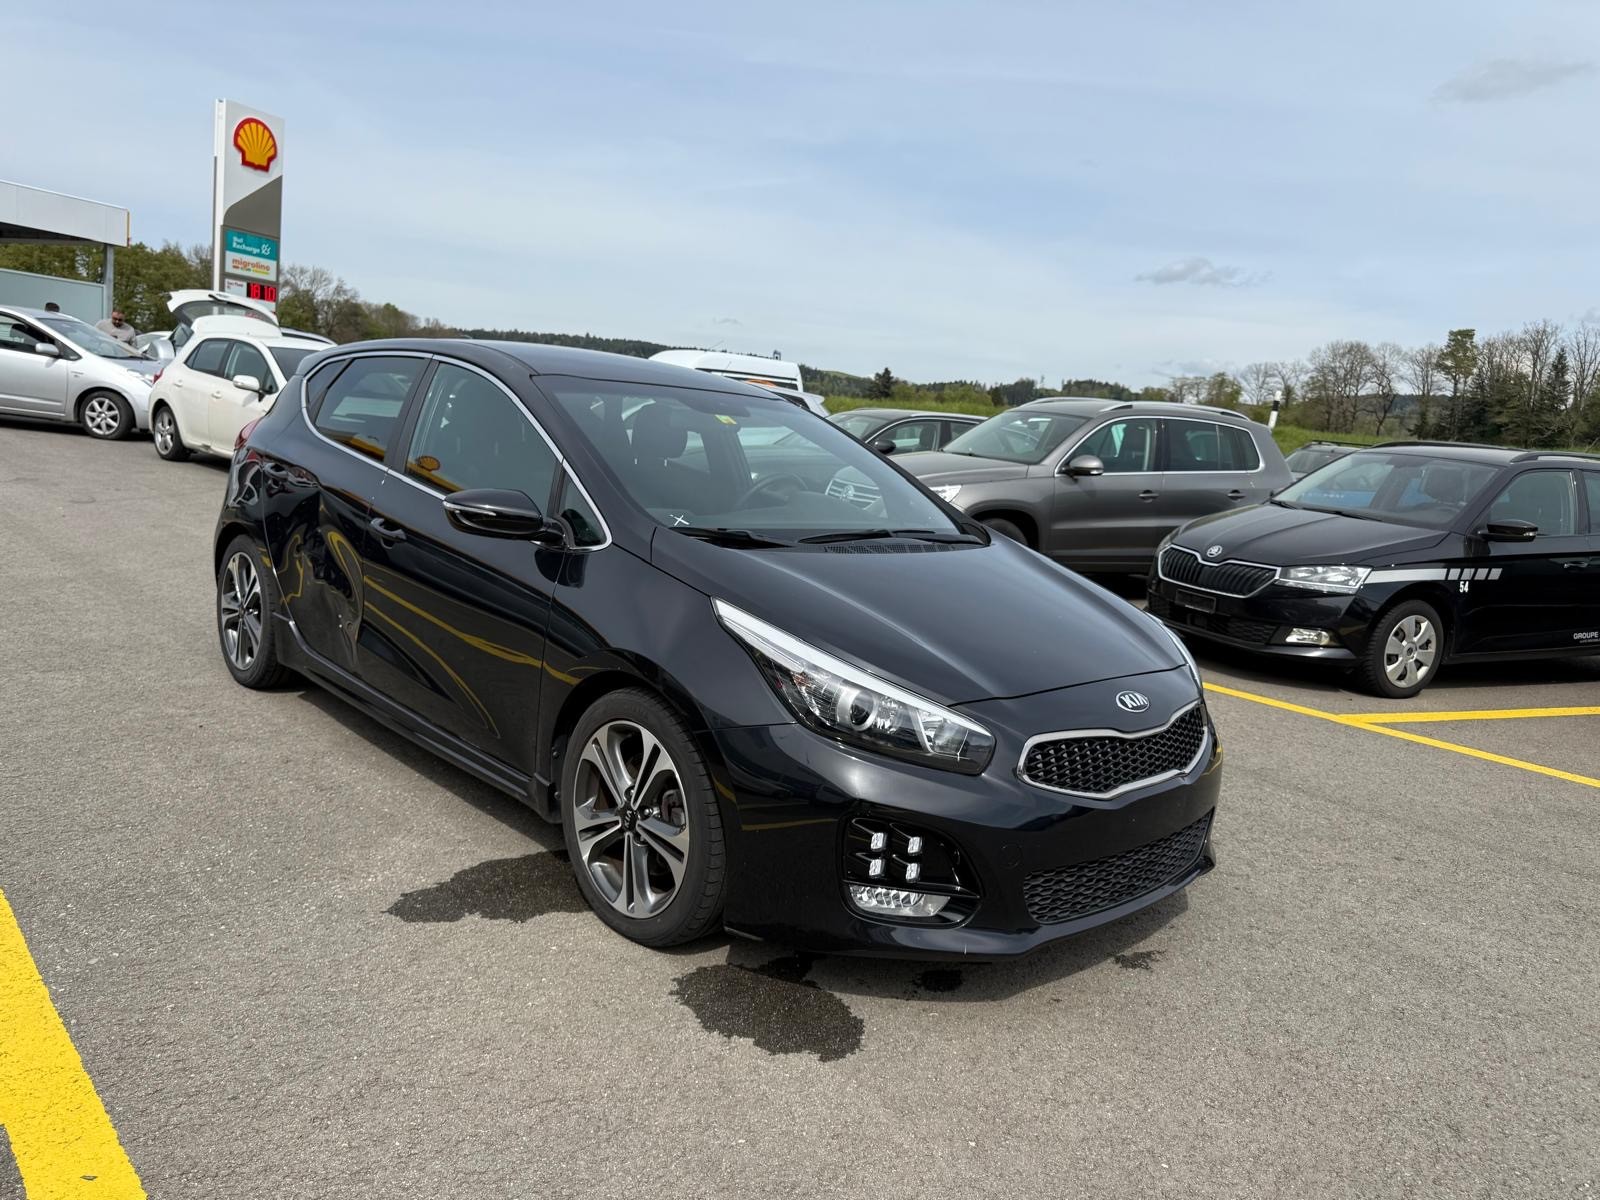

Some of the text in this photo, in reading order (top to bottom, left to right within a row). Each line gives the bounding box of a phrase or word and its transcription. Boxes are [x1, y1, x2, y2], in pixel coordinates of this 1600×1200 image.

[1459, 581, 1469, 593] 54
[1573, 631, 1599, 640] GROUPE
[1119, 693, 1148, 708] KIA
